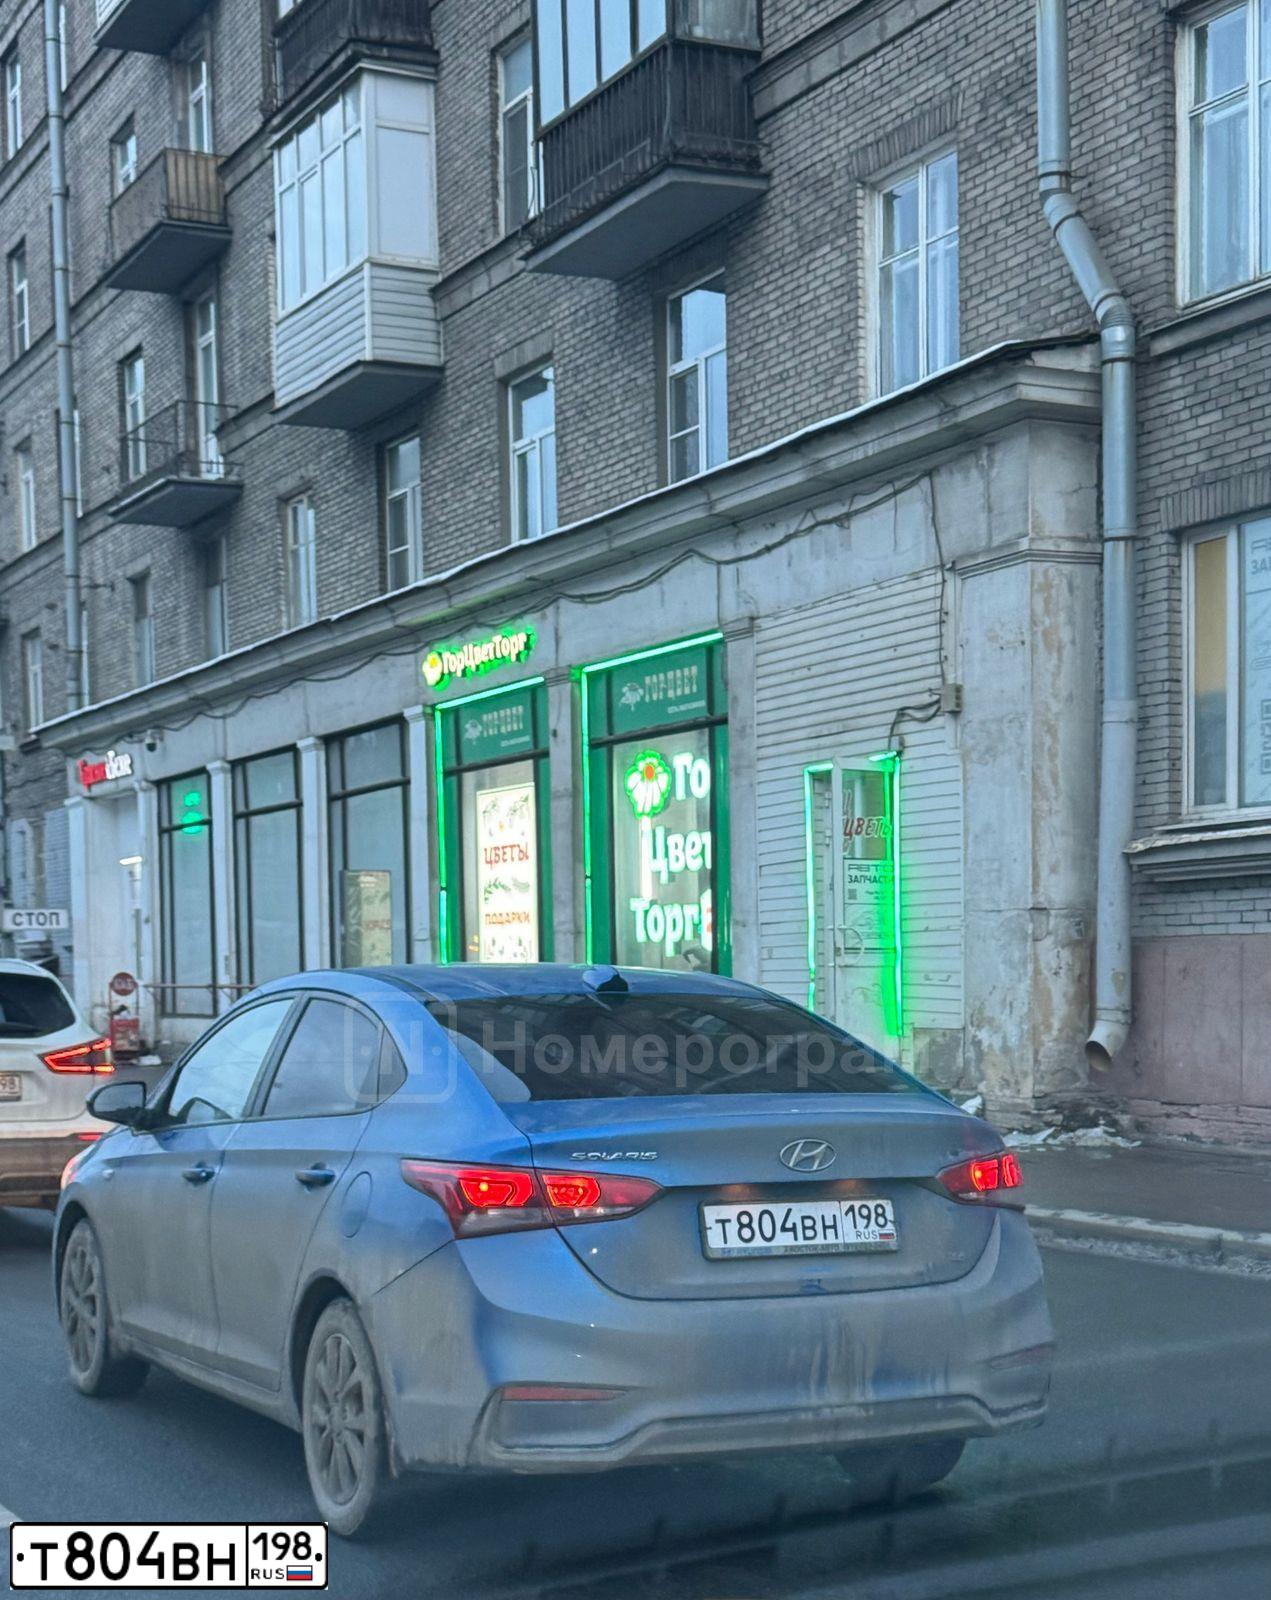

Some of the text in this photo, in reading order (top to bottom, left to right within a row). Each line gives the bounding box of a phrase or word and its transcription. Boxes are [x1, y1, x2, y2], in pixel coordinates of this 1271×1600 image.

[484, 843, 529, 870] ЦВЕТЫ
[12, 911, 60, 927] СТОП
[570, 1151, 658, 1161] SOLARIS
[715, 1203, 887, 1244] Т804ВН 198
[856, 1229, 878, 1240] RUS
